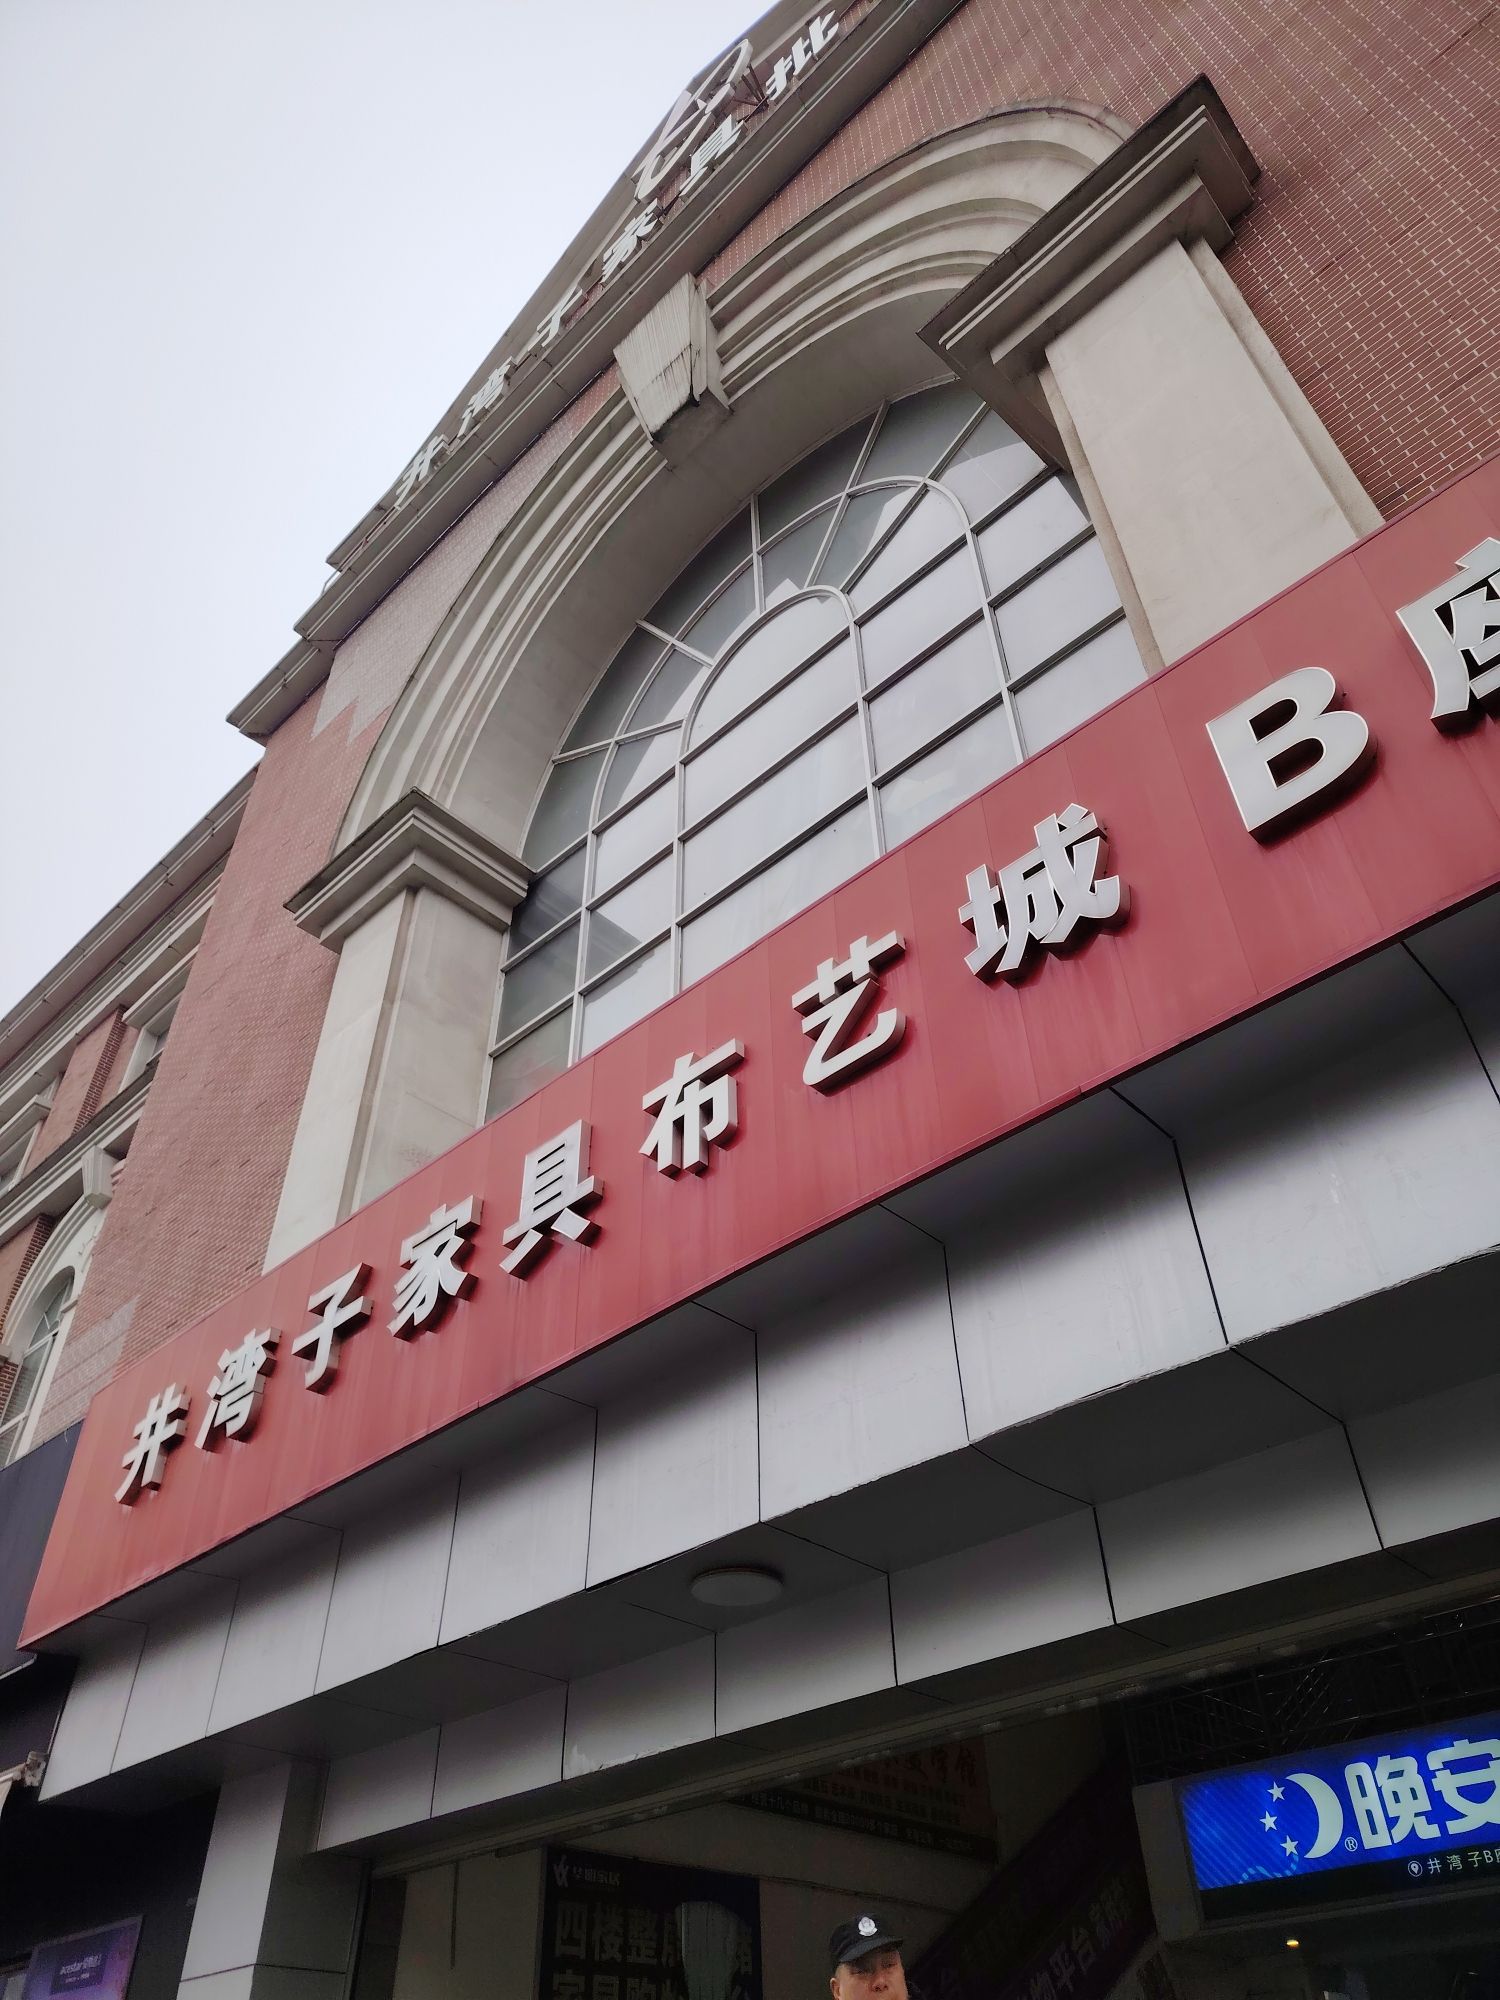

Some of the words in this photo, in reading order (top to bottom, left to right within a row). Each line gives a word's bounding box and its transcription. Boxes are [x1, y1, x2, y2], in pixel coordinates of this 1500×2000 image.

[395, 9, 840, 510] 井湾子家具批
[1344, 1739, 1500, 1850] 晚安
